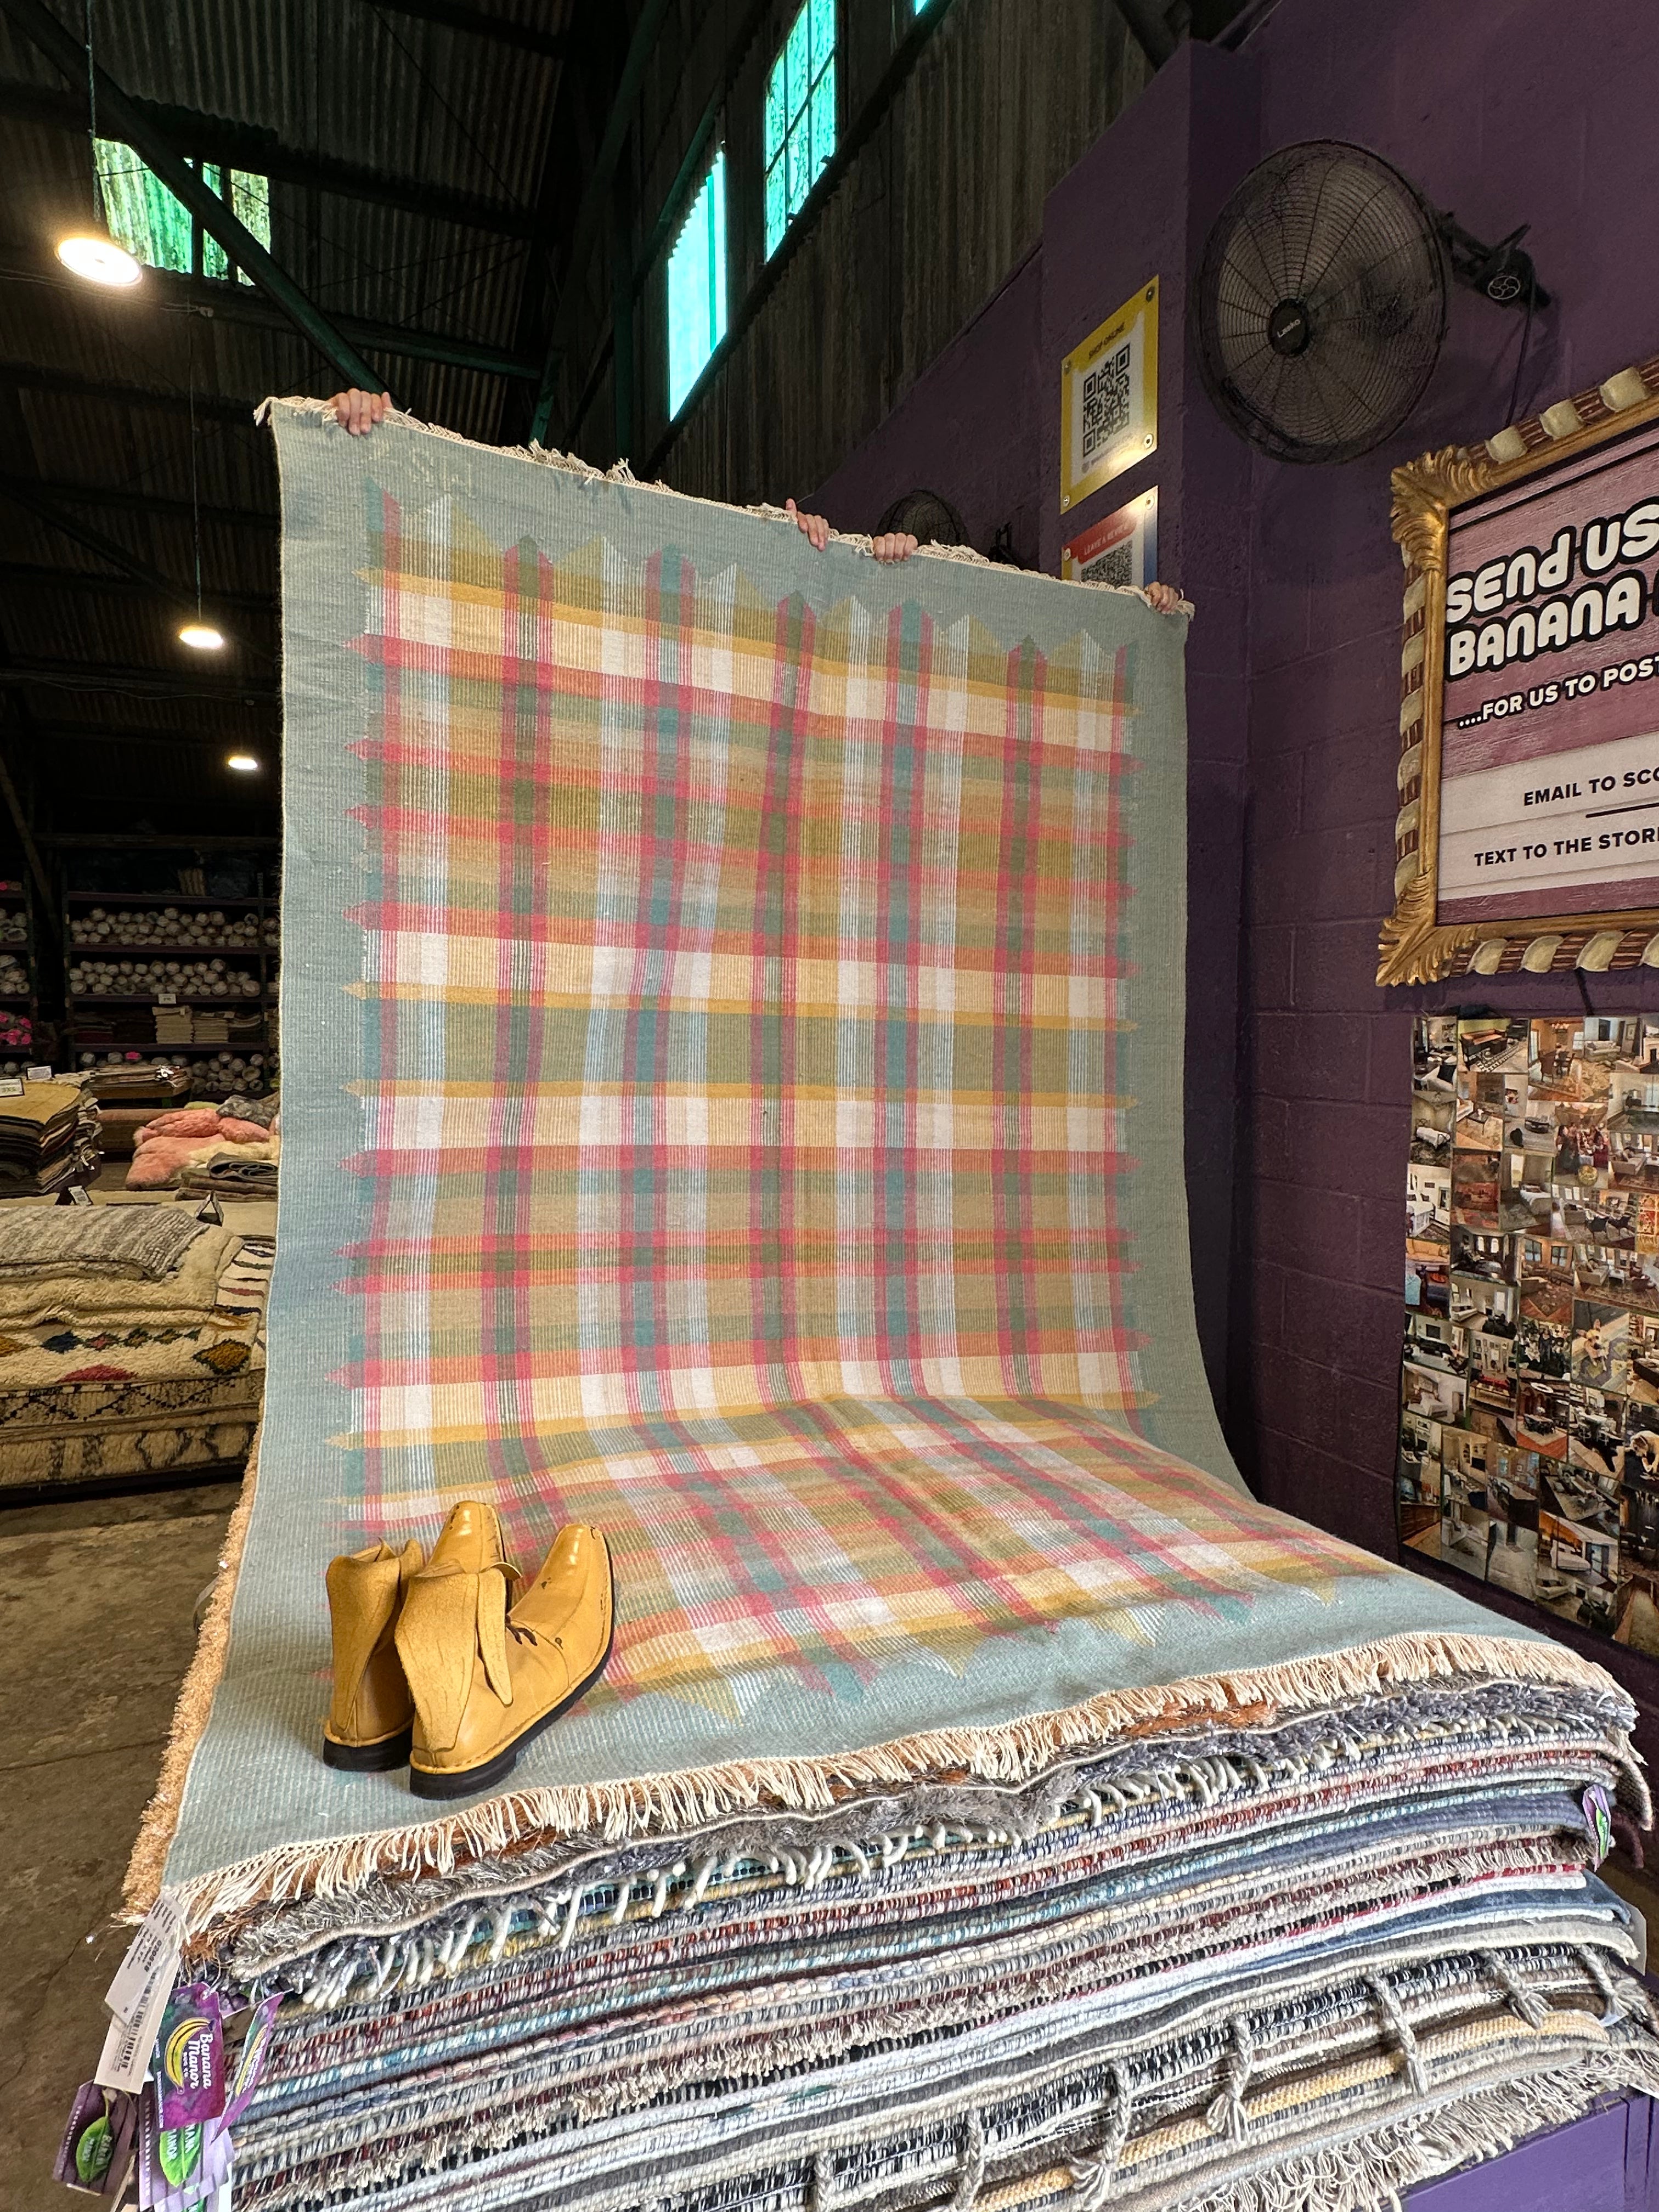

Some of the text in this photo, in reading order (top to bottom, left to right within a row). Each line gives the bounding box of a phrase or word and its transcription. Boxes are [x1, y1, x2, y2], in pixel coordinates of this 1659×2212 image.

[1449, 577, 1640, 676] BANANA
[1530, 685, 1558, 707] US
[1565, 674, 1595, 697] TO
[1524, 783, 1582, 806] EMAIL
[1589, 776, 1616, 793] TO
[1474, 826, 1659, 866] TEXT TO THE STOR
[188, 2040, 200, 2089] Manor
[200, 2033, 214, 2089] Banana
